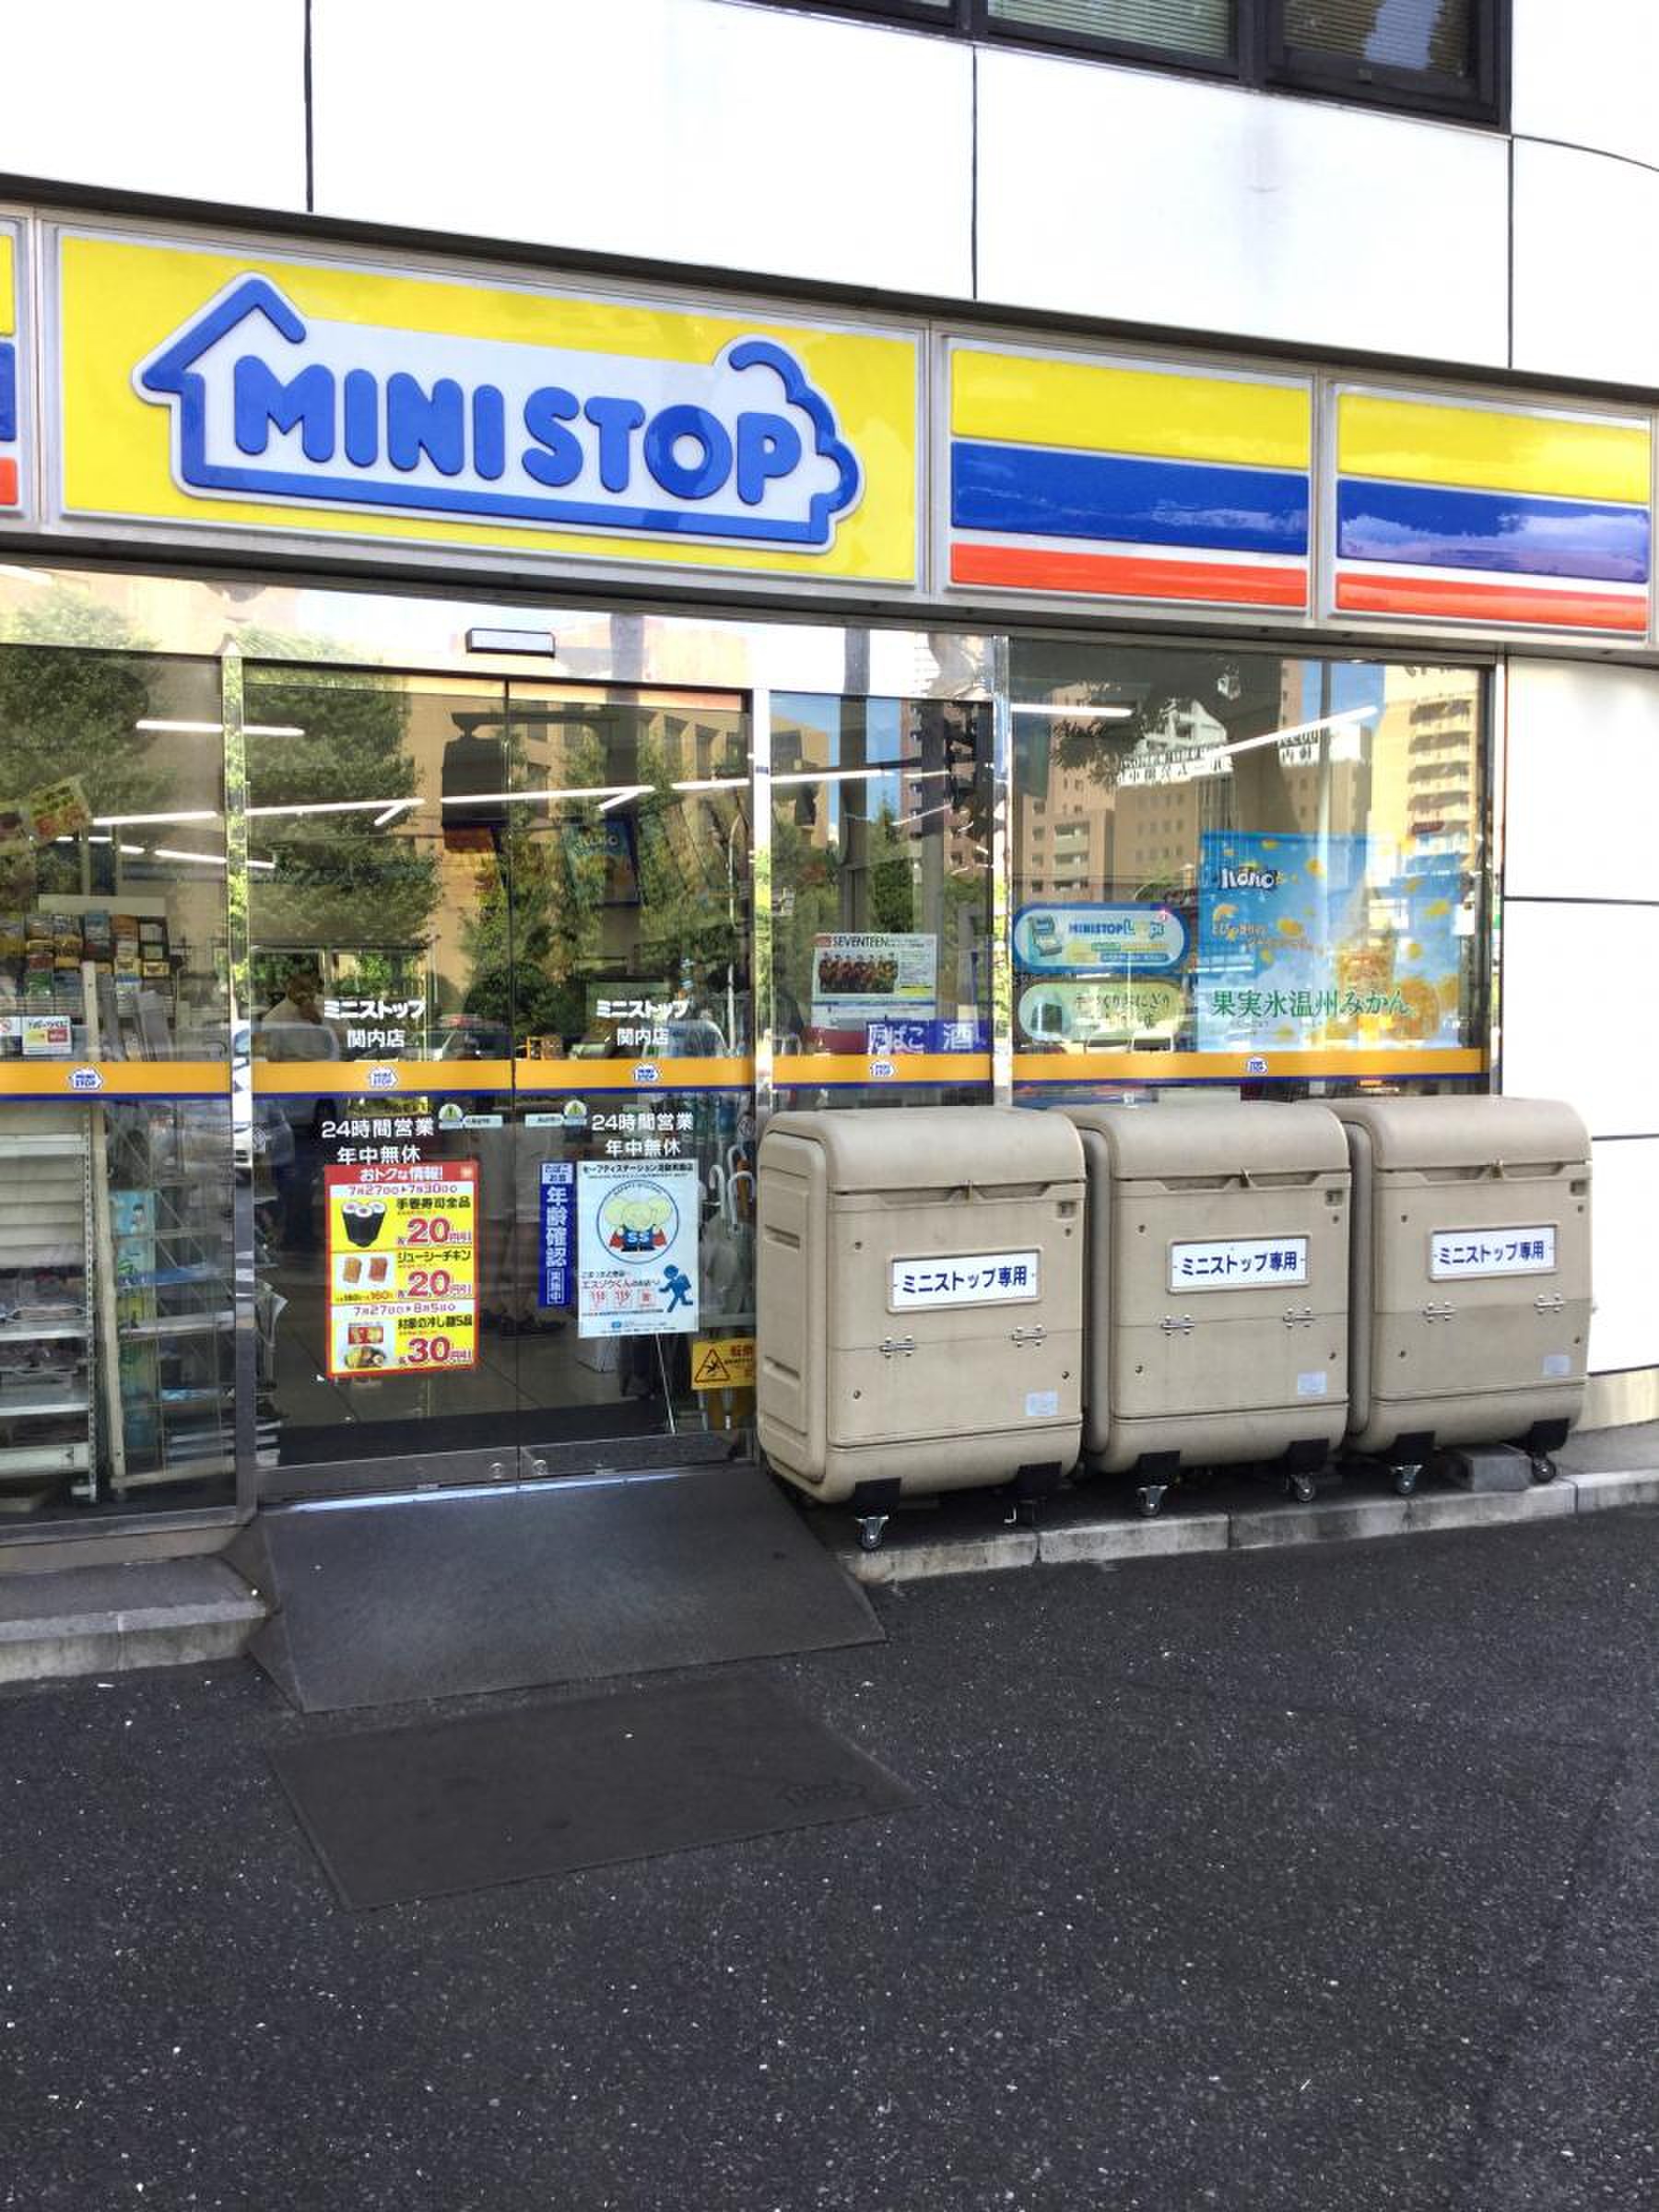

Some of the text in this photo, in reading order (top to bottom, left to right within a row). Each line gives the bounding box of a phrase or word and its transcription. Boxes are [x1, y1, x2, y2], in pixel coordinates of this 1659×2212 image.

[234, 354, 803, 505] MINISTOP
[833, 935, 888, 947] SEVENTEEN
[324, 1000, 427, 1019] ミニストップ
[596, 1000, 689, 1019] ミニストップ
[1212, 989, 1413, 1018] 果実氷温州みかん
[347, 1030, 406, 1048] 関内店
[617, 1028, 669, 1046] 関内店
[943, 1023, 975, 1050] 酒
[322, 1117, 434, 1138] 24時間営業
[592, 1112, 693, 1132] 24時間営業
[337, 1145, 421, 1165] 年中無休
[605, 1138, 681, 1158] 年中無休
[546, 1186, 568, 1267] 年齢確認
[627, 1232, 650, 1243] SS
[398, 1250, 471, 1263] ジューシーチキン
[1440, 1241, 1545, 1265] ミニストップ専用
[1182, 1252, 1298, 1276] ミニストップ専用
[903, 1265, 1028, 1294] ミニストップ専用
